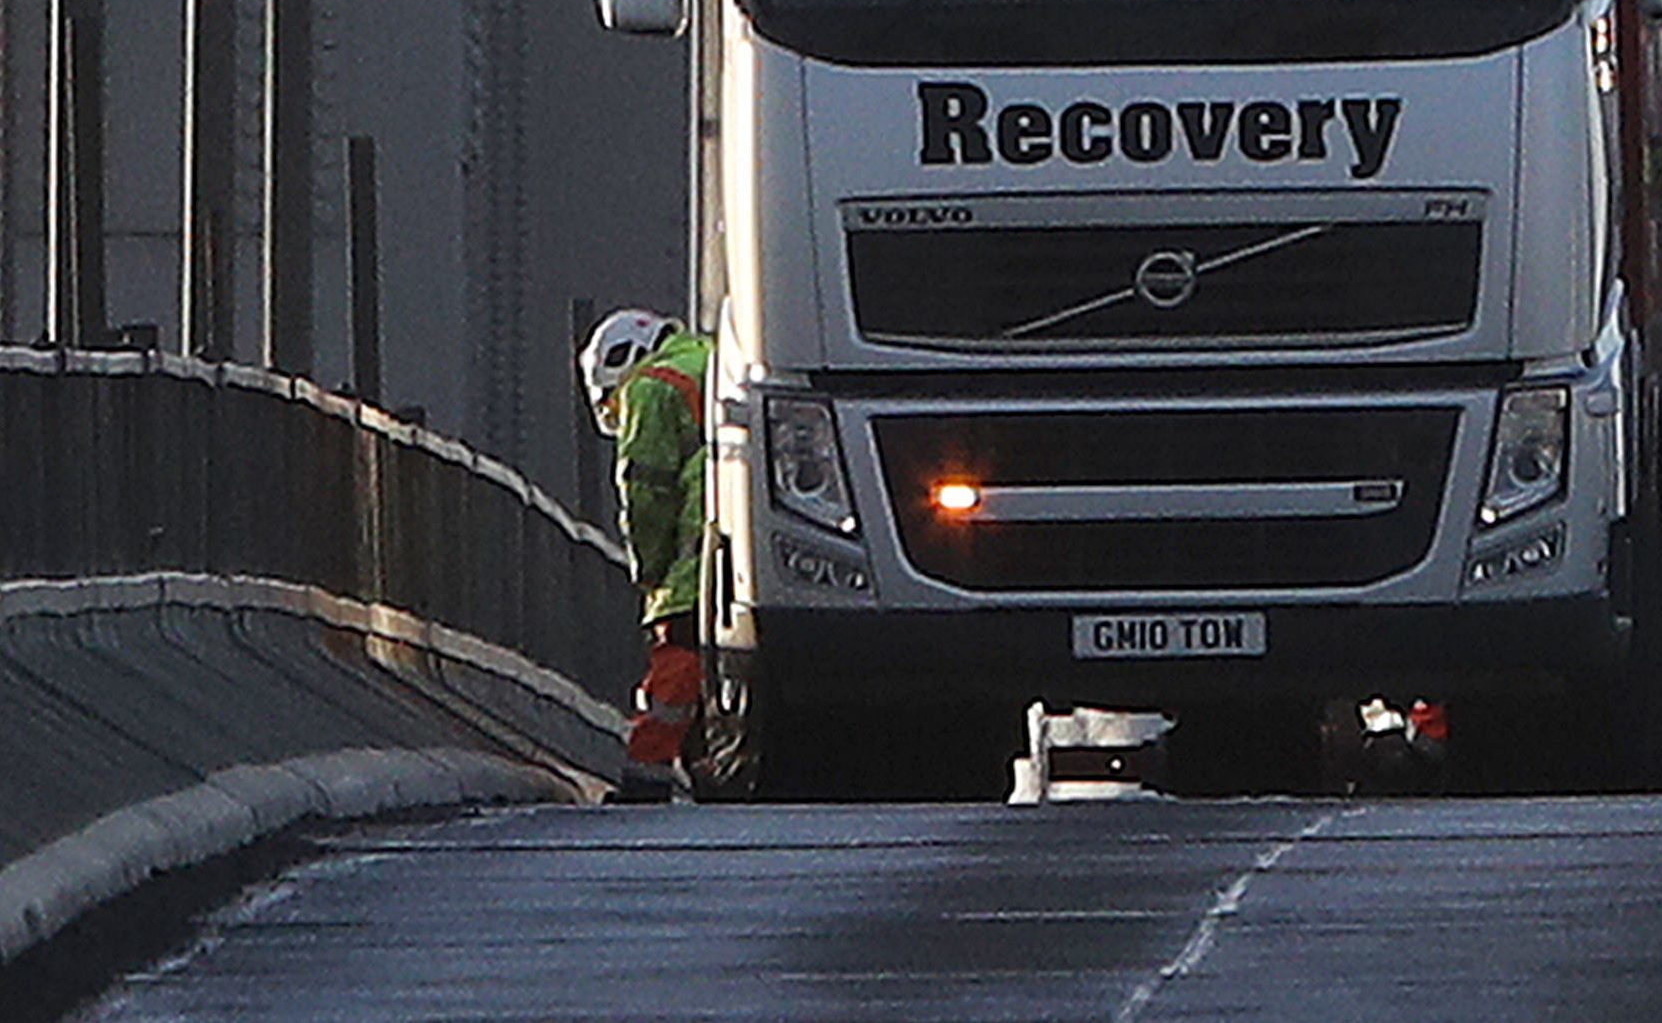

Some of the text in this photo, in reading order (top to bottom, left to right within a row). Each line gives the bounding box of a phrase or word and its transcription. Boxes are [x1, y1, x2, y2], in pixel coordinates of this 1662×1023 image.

[917, 82, 1403, 179] Recovery
[861, 206, 974, 225] VOLVO
[1424, 198, 1469, 218] FH
[1093, 617, 1244, 651] GM10 TOW
